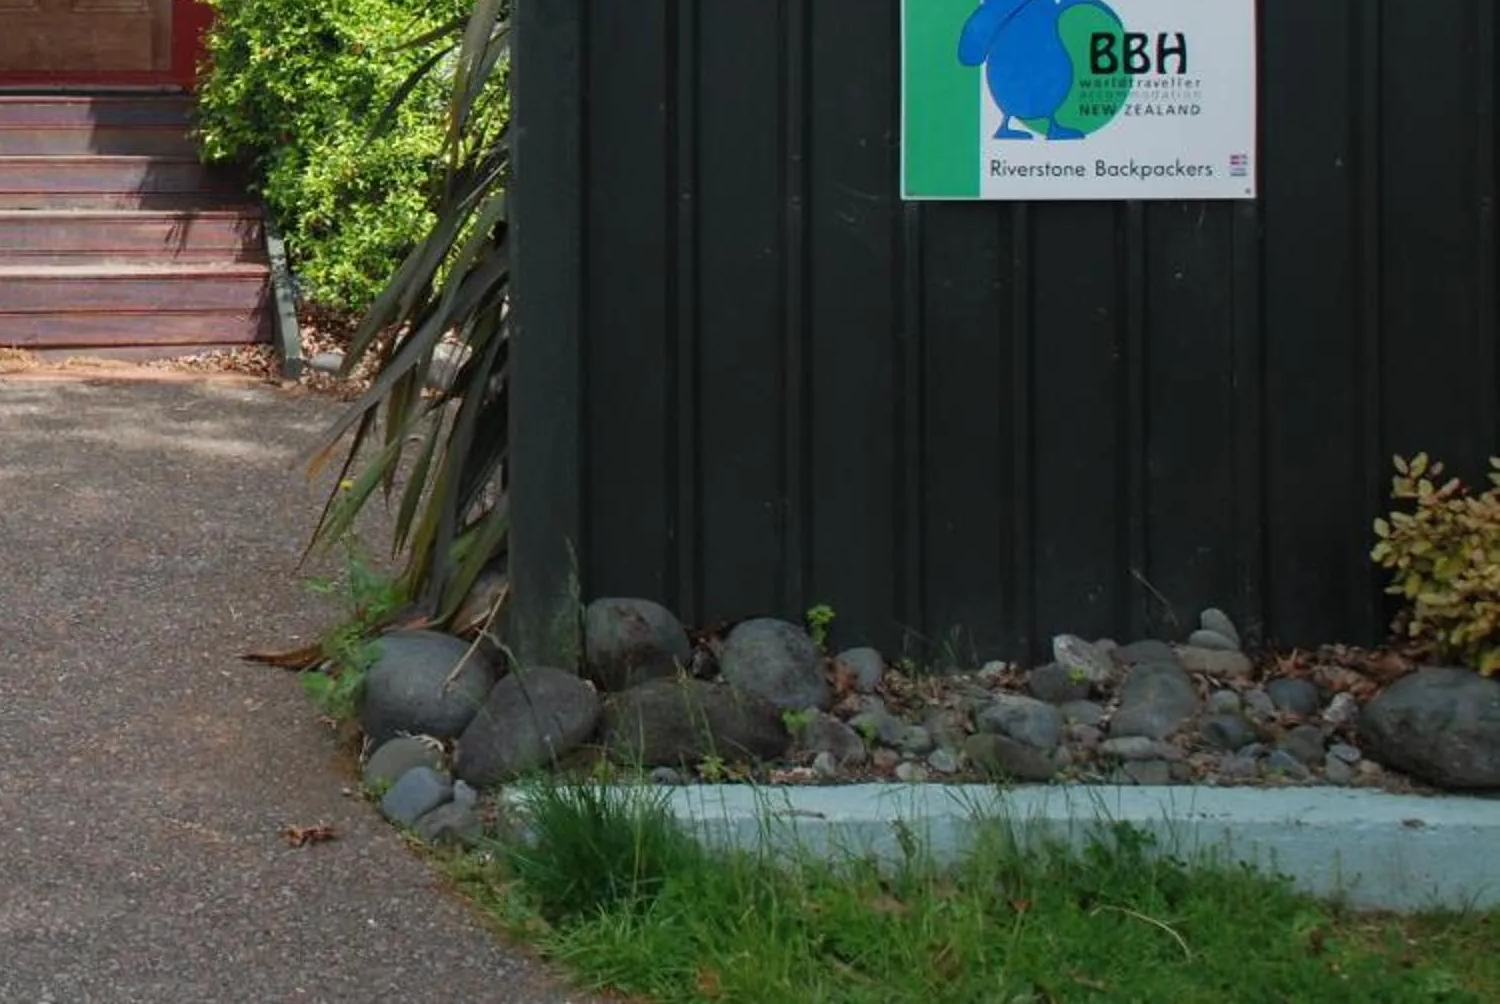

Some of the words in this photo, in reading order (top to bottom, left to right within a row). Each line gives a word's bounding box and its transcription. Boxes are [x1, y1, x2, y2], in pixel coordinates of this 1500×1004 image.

[1090, 32, 1187, 75] BBH
[1079, 104, 1117, 116] NEW
[1124, 104, 1202, 117] ZEALAND
[990, 159, 1086, 177] Riverstone
[1095, 158, 1214, 180] Backpackers
